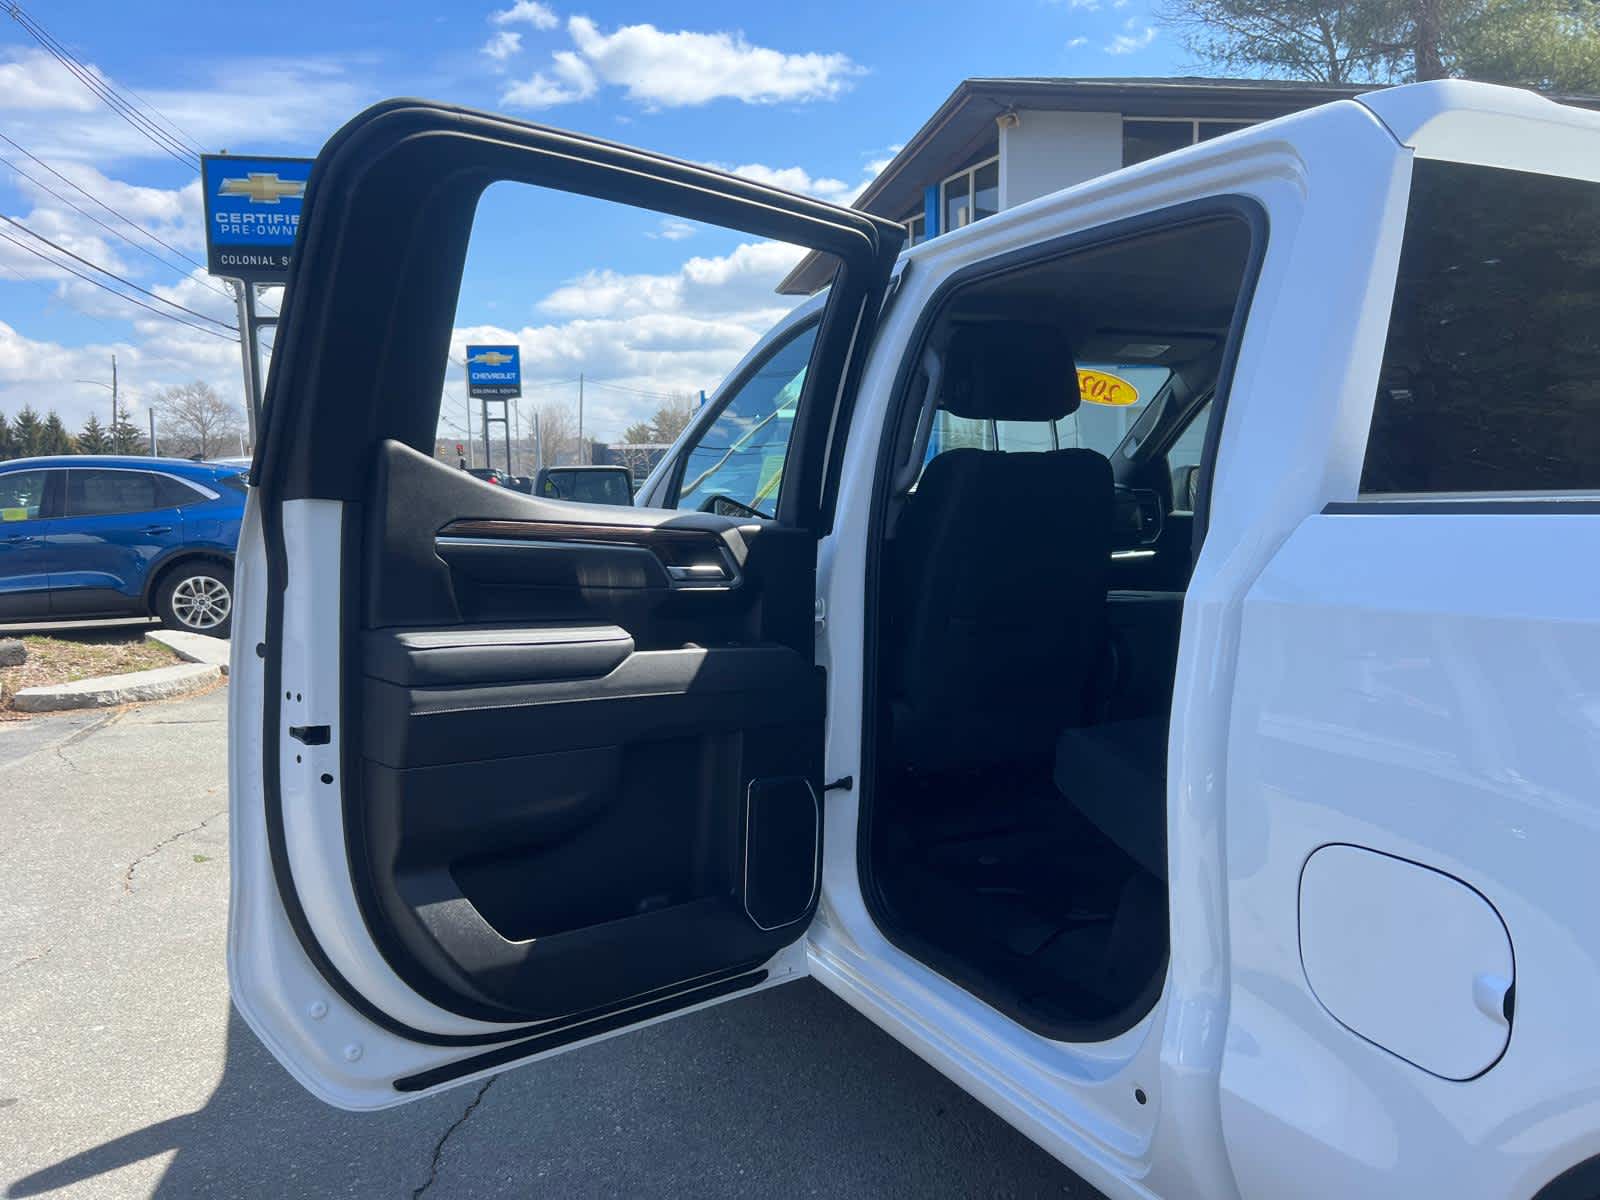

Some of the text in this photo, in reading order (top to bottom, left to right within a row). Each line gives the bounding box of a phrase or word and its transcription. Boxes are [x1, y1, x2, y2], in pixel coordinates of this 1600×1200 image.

[215, 212, 300, 225] CERTIFIE
[220, 254, 275, 266] COLONIAL
[471, 372, 516, 381] CHEVROLET
